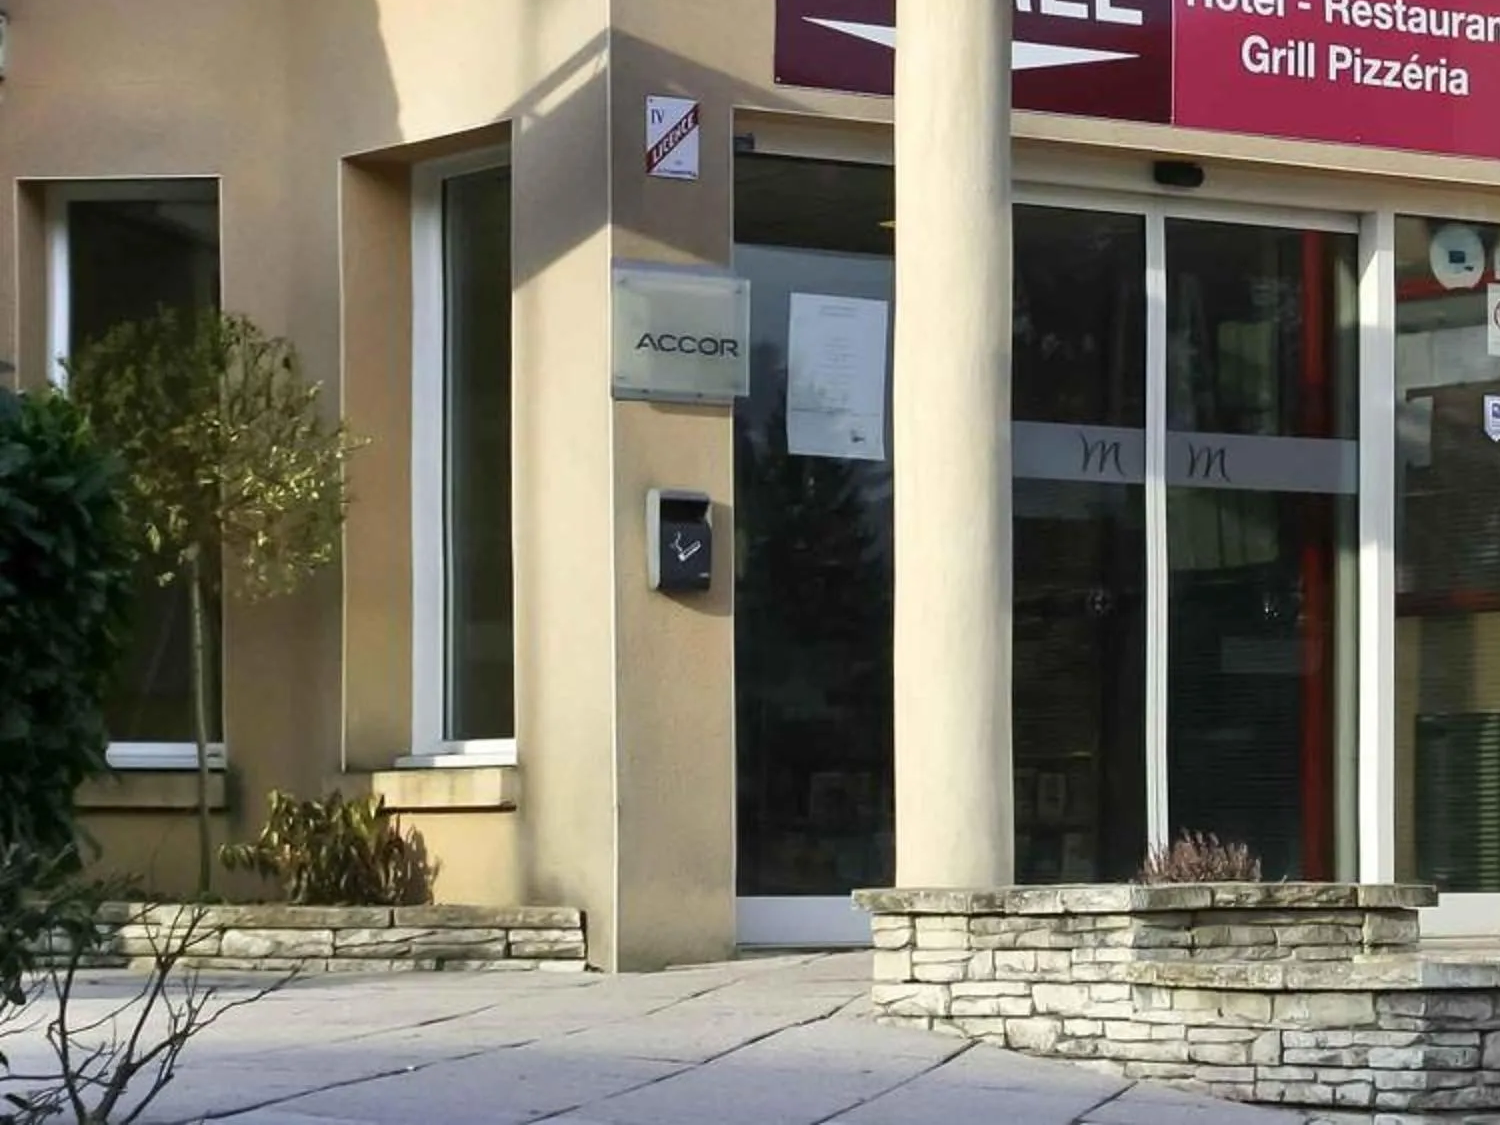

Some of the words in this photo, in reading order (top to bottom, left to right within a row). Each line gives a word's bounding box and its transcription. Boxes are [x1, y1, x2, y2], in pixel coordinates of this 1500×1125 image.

[1241, 35, 1316, 79] Grill
[1328, 44, 1469, 96] Pizzéria
[635, 332, 739, 357] ACCOR
